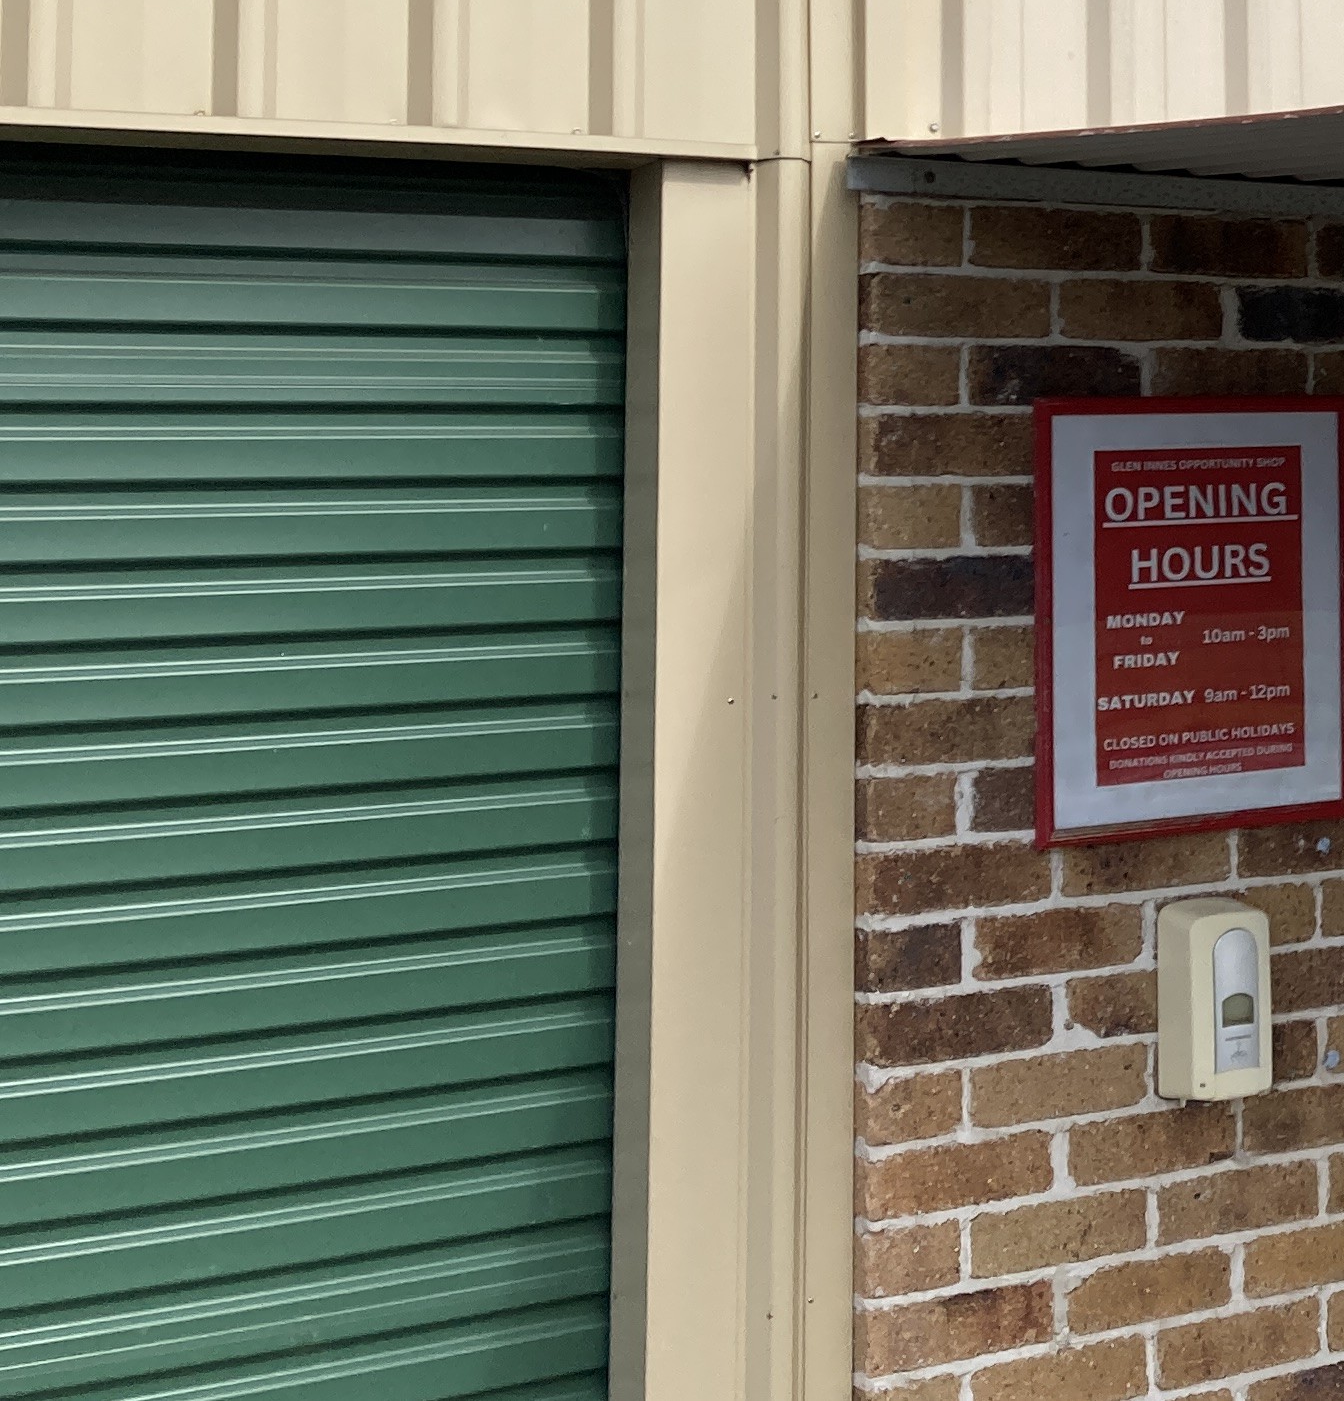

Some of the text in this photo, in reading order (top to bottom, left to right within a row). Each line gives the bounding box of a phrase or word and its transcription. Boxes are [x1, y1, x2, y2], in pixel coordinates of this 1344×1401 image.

[1111, 461, 1141, 472] GLEN
[1178, 458, 1254, 470] OPPORTUNITY
[1256, 457, 1286, 468] SHOP
[1104, 482, 1288, 522] OPENING
[1131, 543, 1271, 583] HOURS
[1106, 611, 1185, 629] MONDAY
[1139, 635, 1153, 646] to
[1202, 628, 1245, 644] 10am
[1257, 625, 1290, 644] 3pm
[1112, 651, 1180, 670] FRIDAY
[1097, 689, 1195, 711] SATURDAY
[1204, 688, 1238, 703] 9am
[1249, 684, 1291, 701] 12pm
[1103, 722, 1295, 751] CLOSED ON PUBLIC HOLIDAYS
[1108, 755, 1168, 770] DONATIONS
[1205, 747, 1254, 761] ACCEPTED
[1256, 742, 1293, 756] DURING
[1163, 762, 1242, 779] OPENING HOURS
